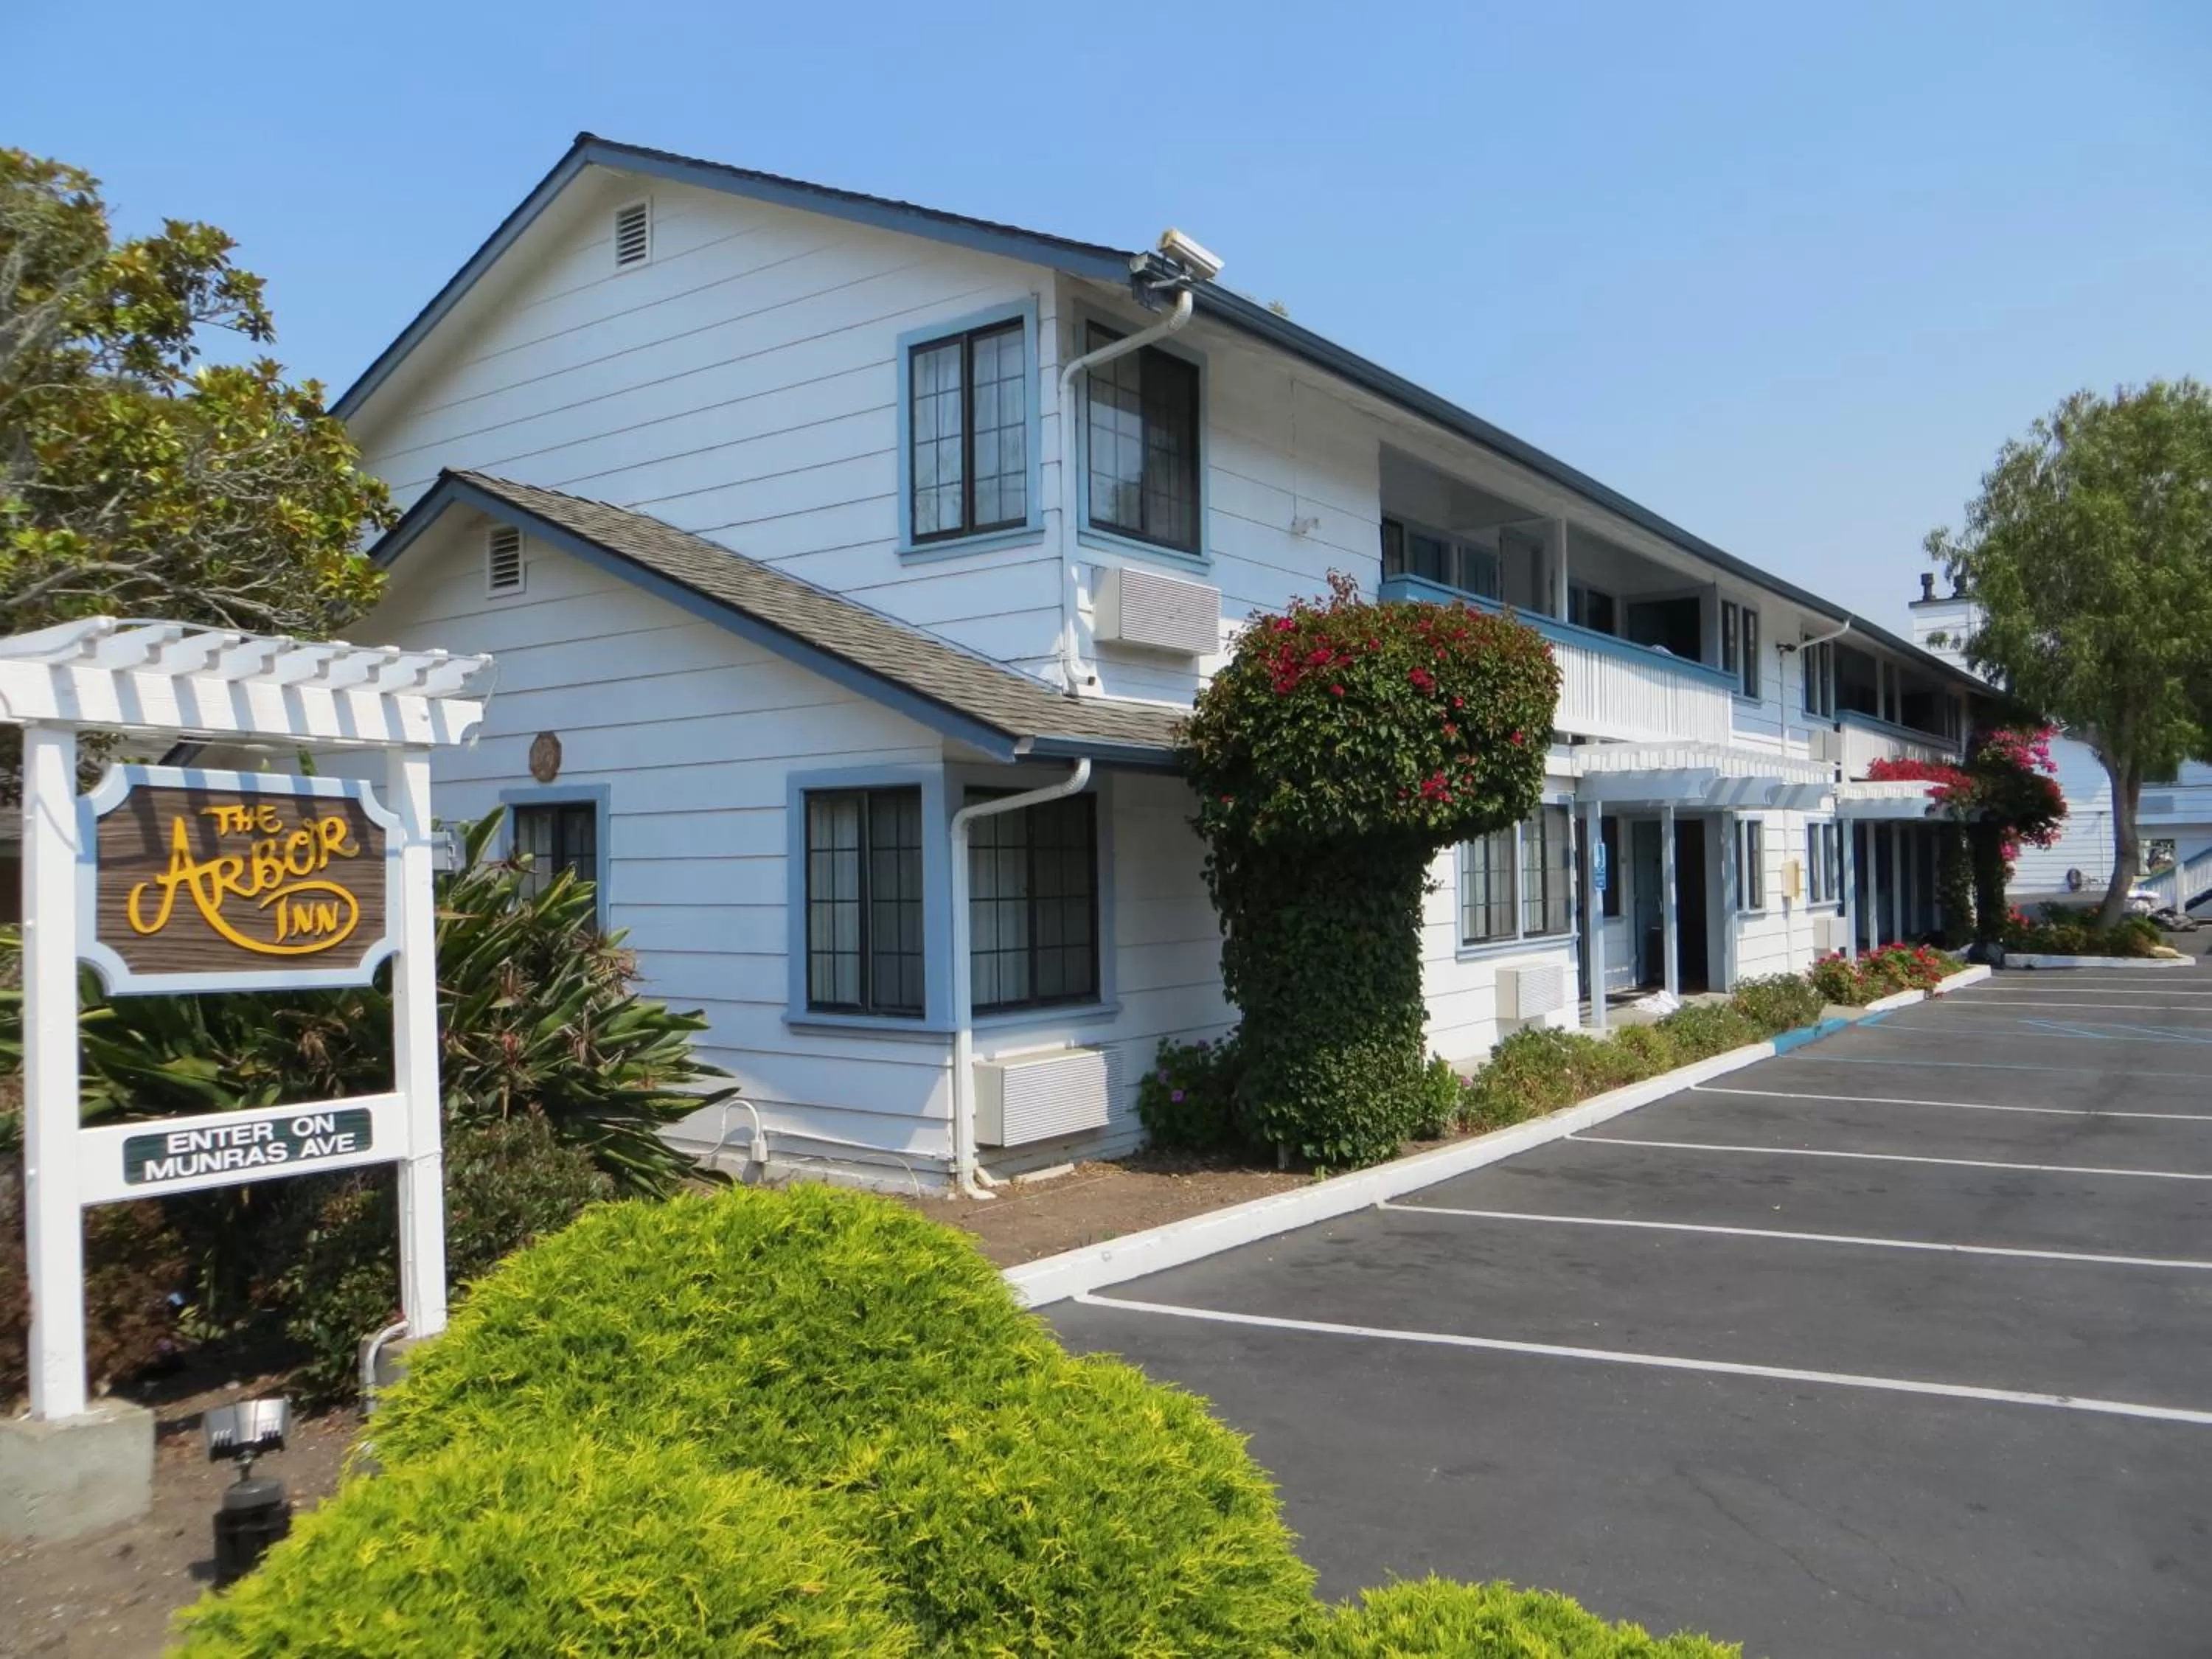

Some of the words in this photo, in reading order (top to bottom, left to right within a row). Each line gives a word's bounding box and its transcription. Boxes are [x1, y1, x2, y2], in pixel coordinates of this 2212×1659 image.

[201, 804, 283, 836] THE
[128, 816, 360, 935] ARBOR
[274, 895, 340, 944] INN
[145, 1141, 288, 1181] MUNRAS
[299, 1132, 355, 1158] AVE
[167, 1121, 274, 1155] ENTER
[291, 1113, 335, 1137] ON
